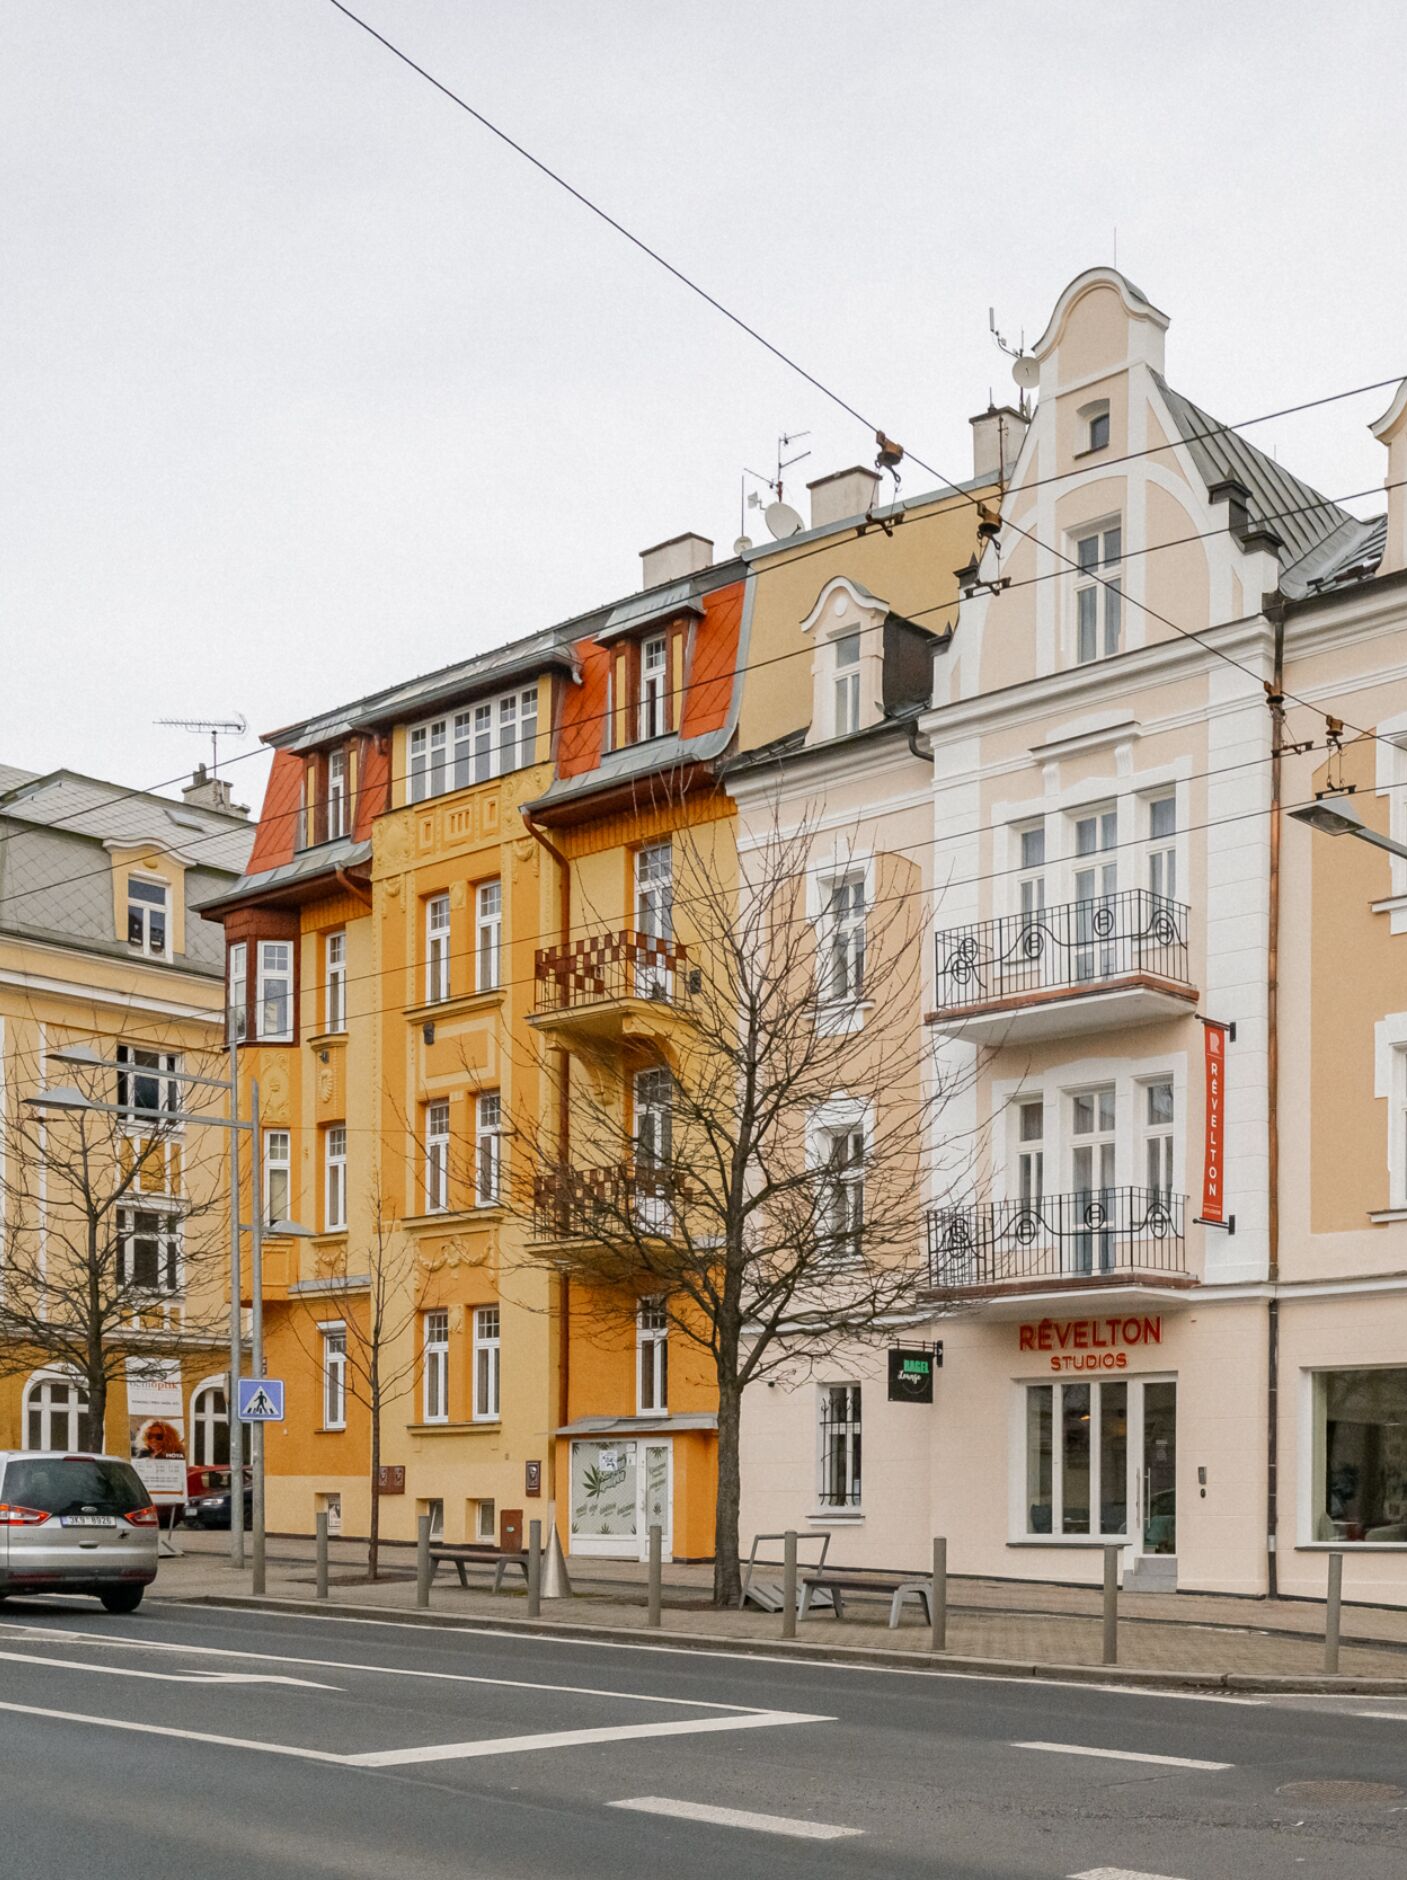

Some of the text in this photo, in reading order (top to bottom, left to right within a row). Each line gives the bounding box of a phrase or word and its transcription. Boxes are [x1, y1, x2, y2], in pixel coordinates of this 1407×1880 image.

[1208, 1062, 1218, 1197] RÊVELTON
[1019, 1317, 1161, 1351] RÊVELTON
[1050, 1353, 1128, 1371] STUDIOS
